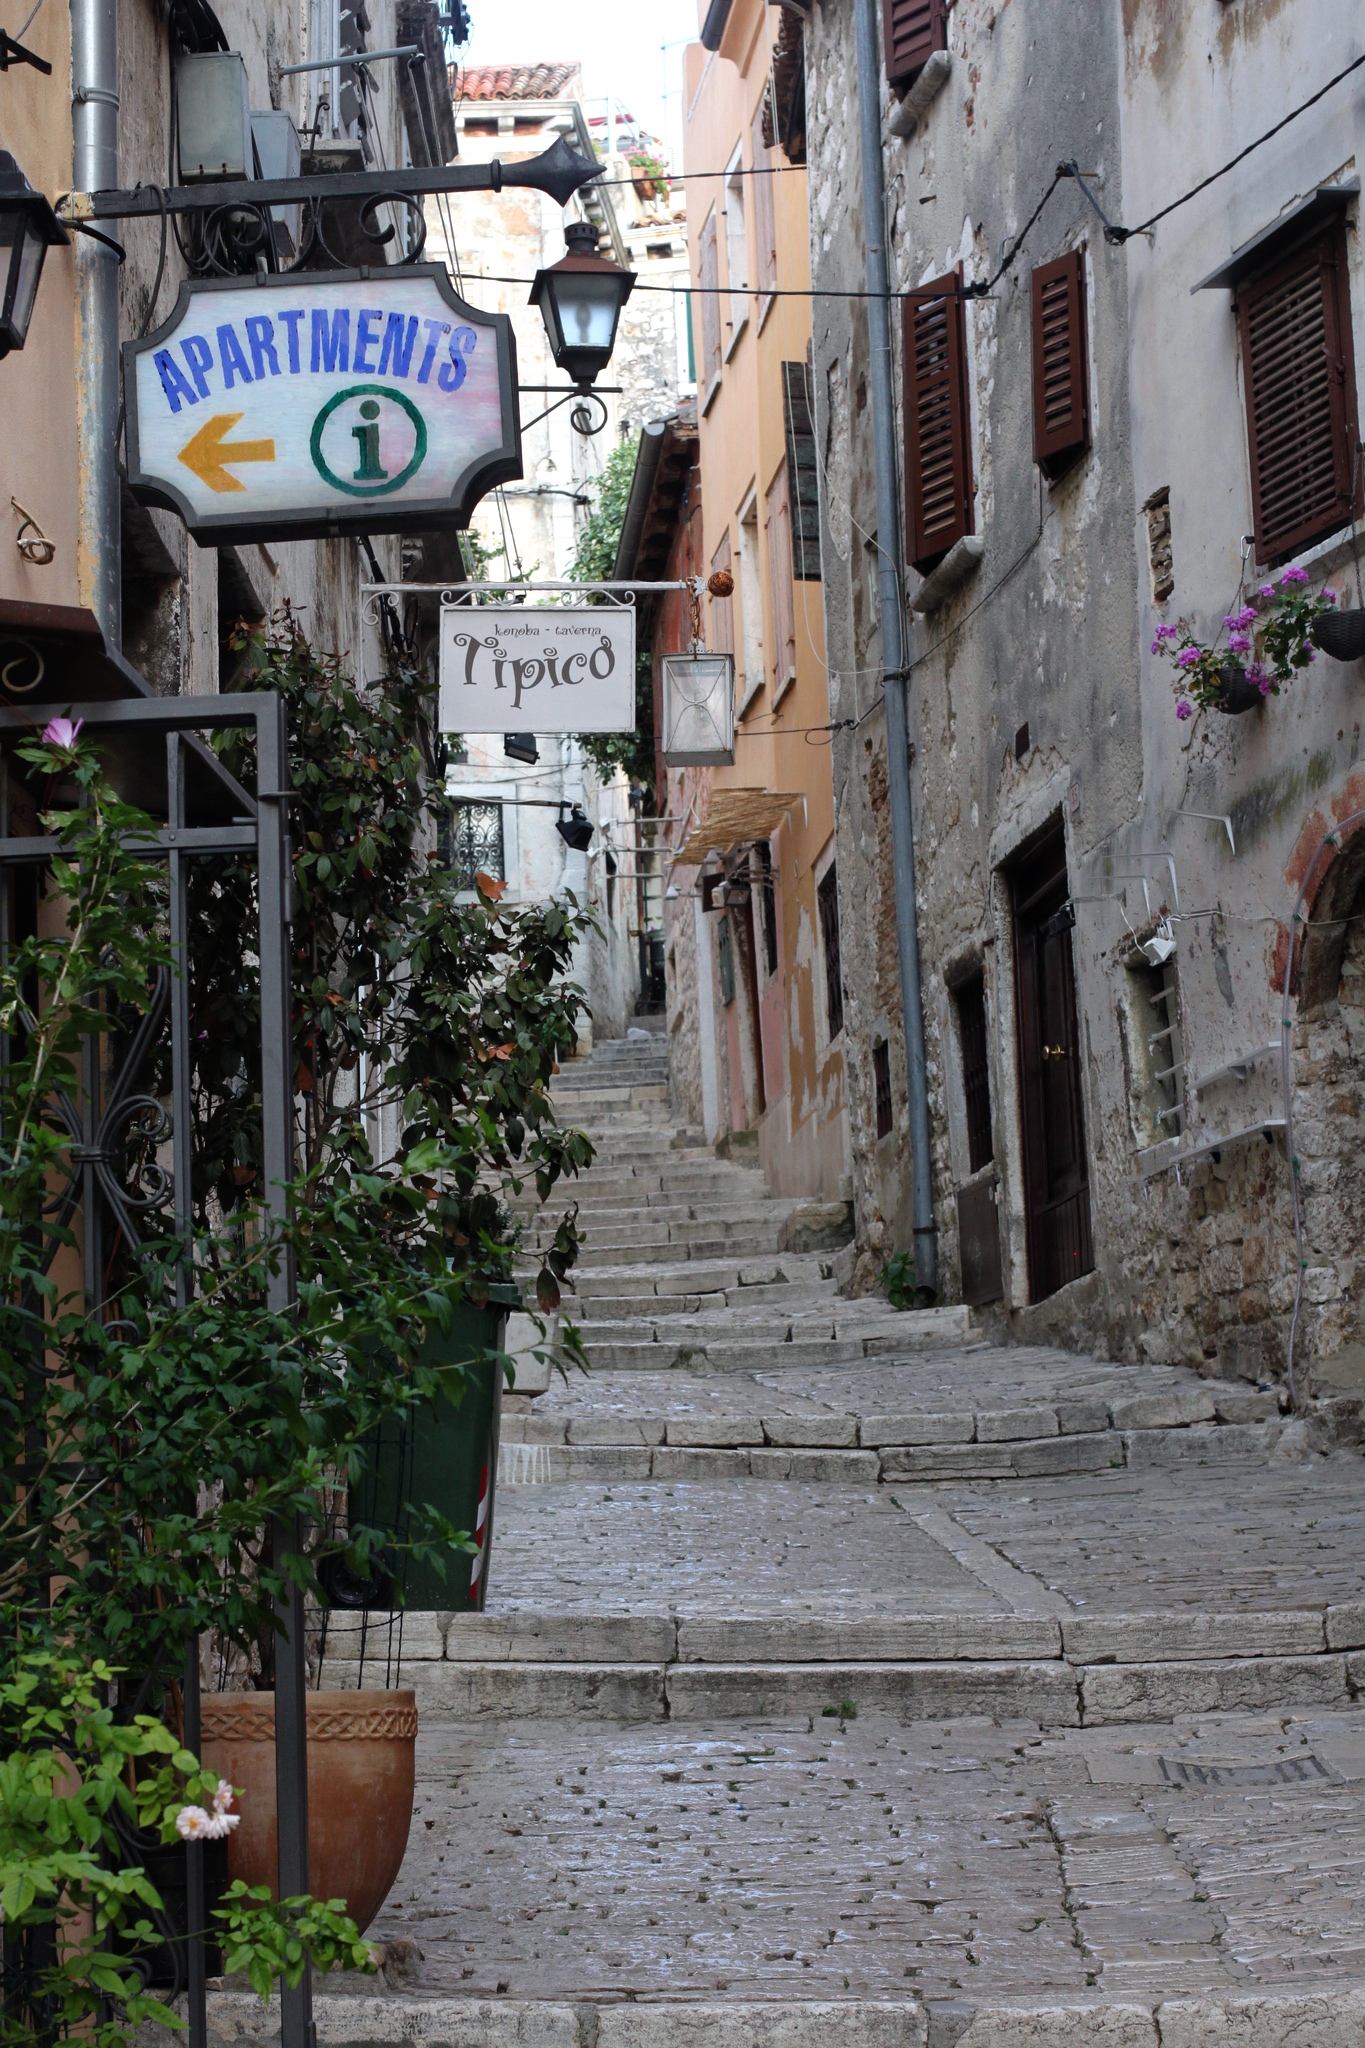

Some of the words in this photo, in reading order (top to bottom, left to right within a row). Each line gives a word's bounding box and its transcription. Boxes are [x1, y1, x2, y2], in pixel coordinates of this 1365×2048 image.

[153, 309, 478, 414] APARTMENTS
[494, 624, 540, 638] konoba
[555, 625, 602, 637] taverna
[453, 633, 616, 710] Tipico
